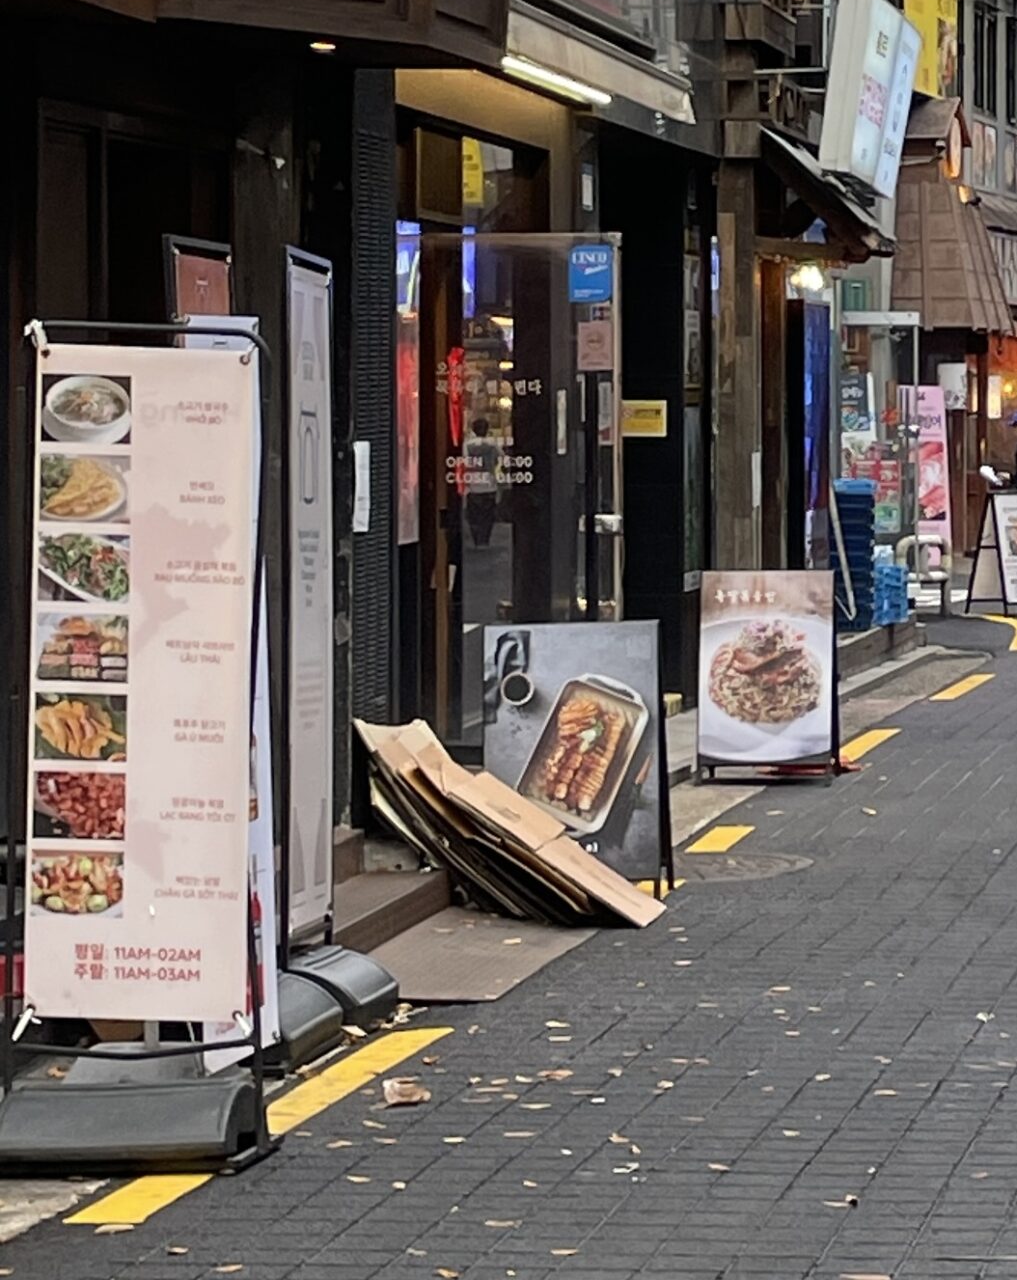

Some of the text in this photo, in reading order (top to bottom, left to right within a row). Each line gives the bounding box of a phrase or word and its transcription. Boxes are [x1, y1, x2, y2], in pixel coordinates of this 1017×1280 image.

[445, 455, 483, 468] OPEN
[445, 471, 492, 484] CLOSE
[114, 946, 202, 962] 11AM-02AM
[114, 965, 201, 982] 11AM-03AM
